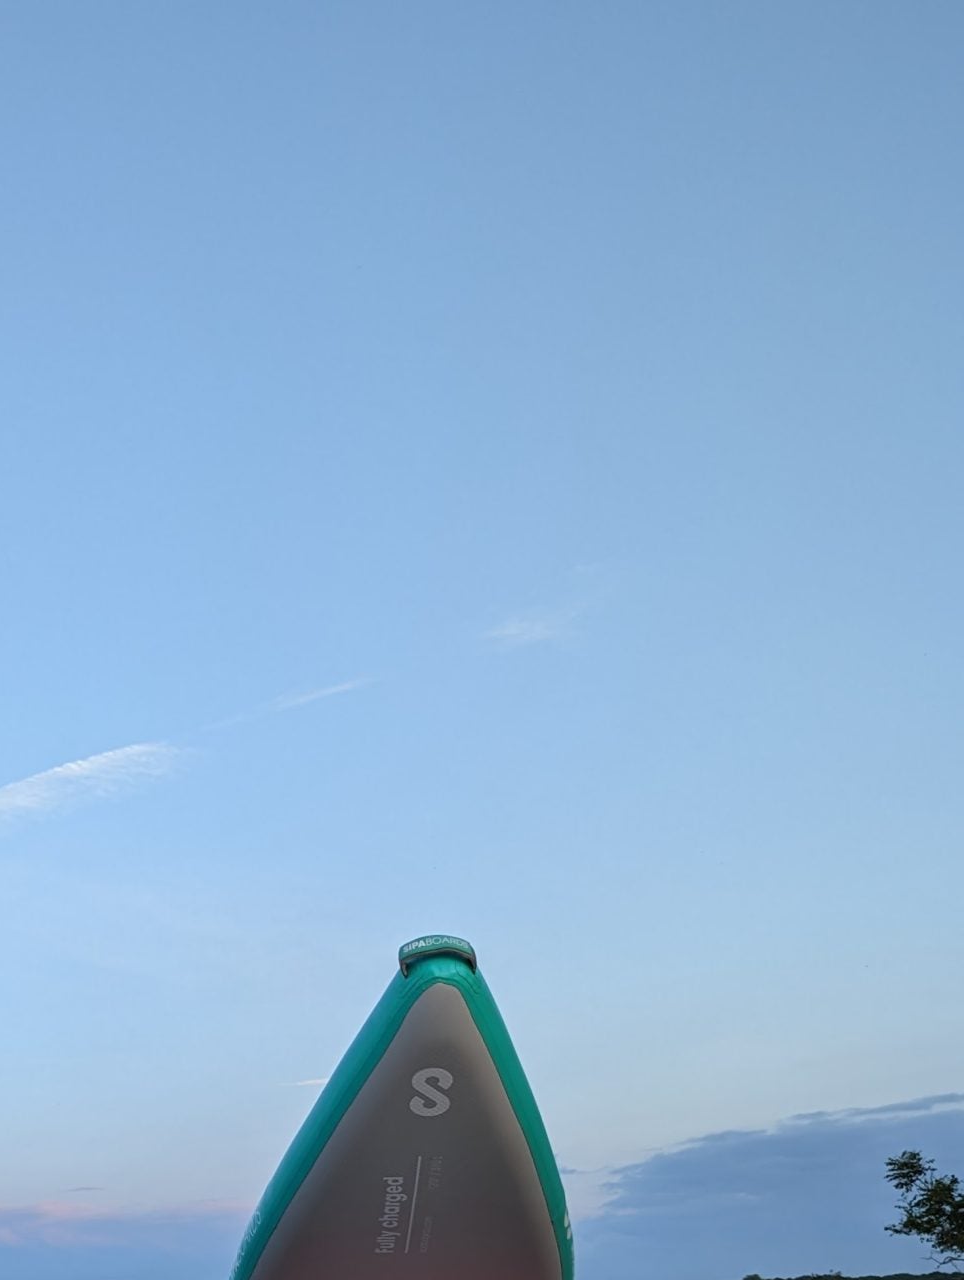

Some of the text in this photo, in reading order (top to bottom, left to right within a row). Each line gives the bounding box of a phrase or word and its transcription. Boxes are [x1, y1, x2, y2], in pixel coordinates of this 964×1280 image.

[402, 937, 470, 952] SIPABOARDS
[374, 1176, 408, 1254] Fully charged
